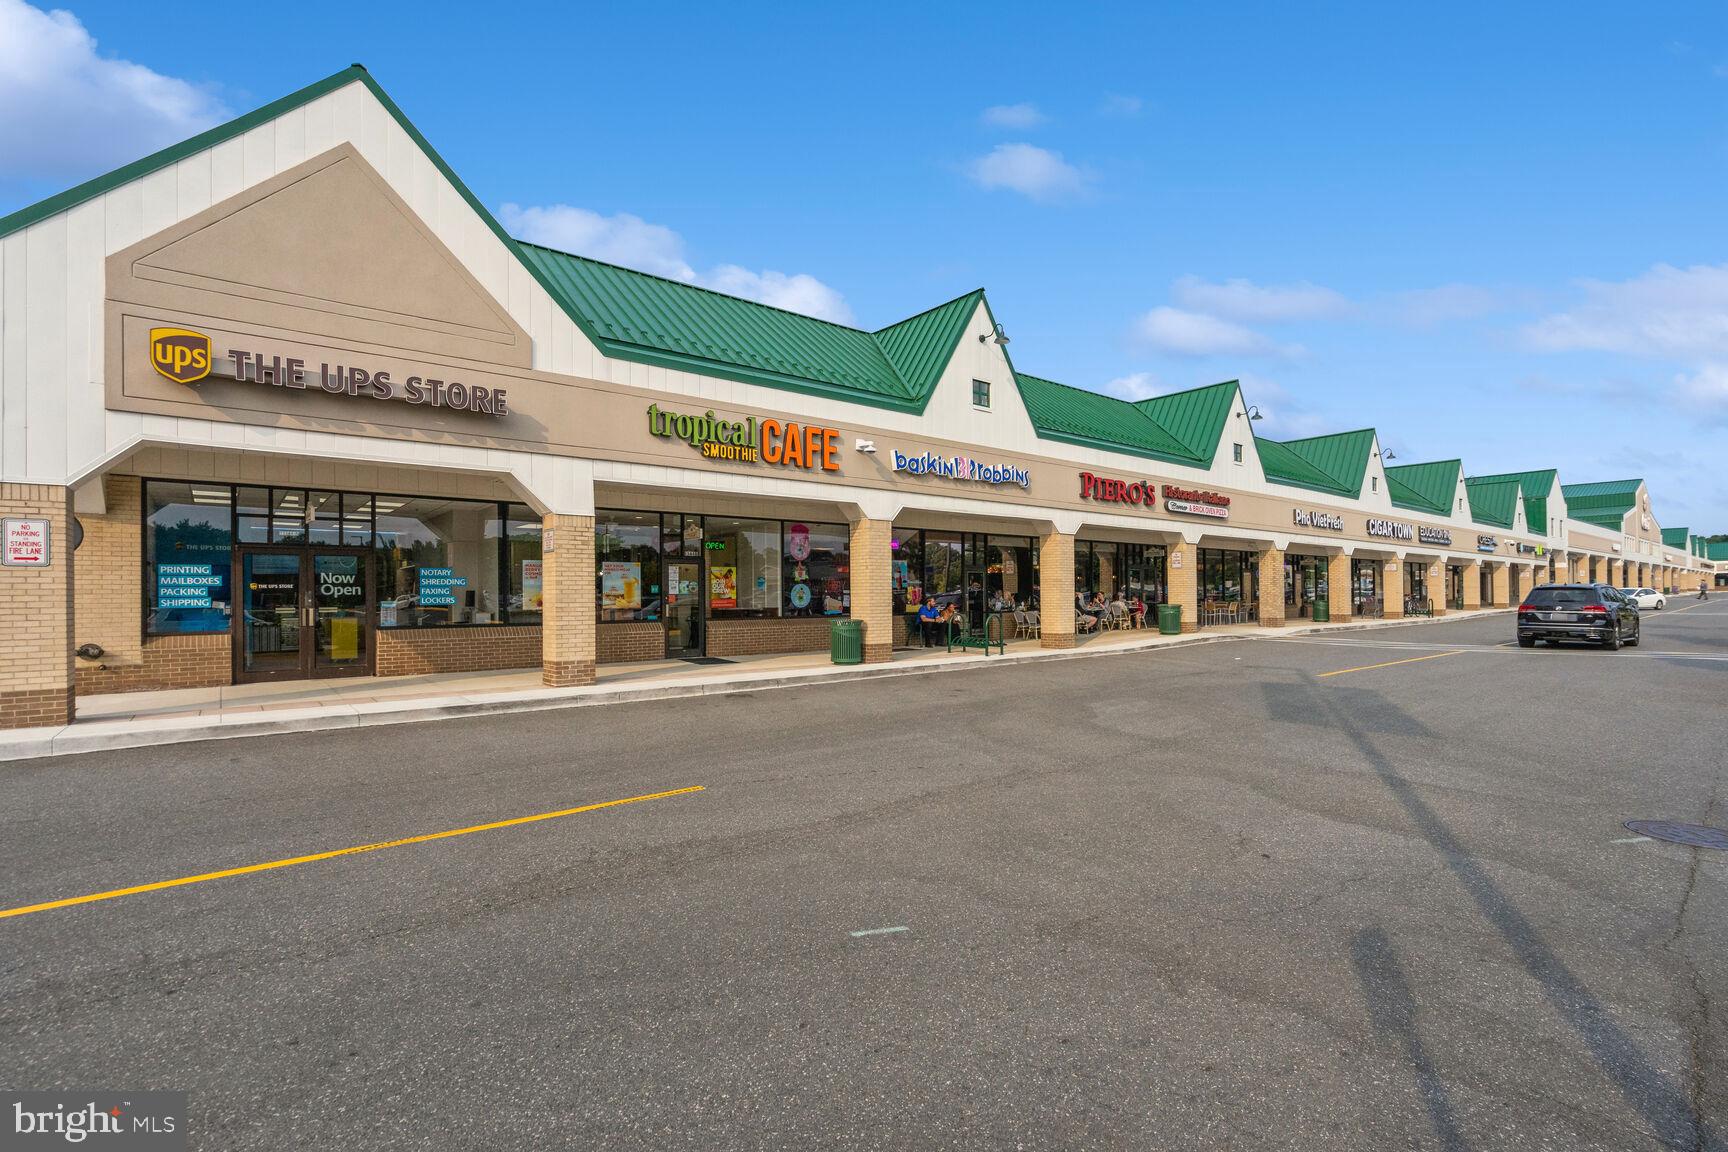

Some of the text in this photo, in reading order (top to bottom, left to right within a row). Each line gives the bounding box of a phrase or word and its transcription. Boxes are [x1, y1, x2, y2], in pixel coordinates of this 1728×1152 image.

[155, 342, 207, 374] ups
[228, 349, 509, 416] THE UPS STORE
[647, 402, 757, 447] tropical
[703, 442, 758, 463] SMOOTHIE
[760, 418, 840, 471] CAFE
[891, 450, 953, 476] baskin
[976, 462, 1029, 488] robbins
[1080, 472, 1155, 506] PIERO'S
[1294, 509, 1310, 525] Pho
[160, 566, 210, 574] PRINTING
[320, 572, 356, 584] Now
[160, 577, 220, 585] MAILBOXES
[160, 588, 206, 596] PACKING
[320, 584, 362, 598] Open
[160, 599, 210, 607] SHIPPING
